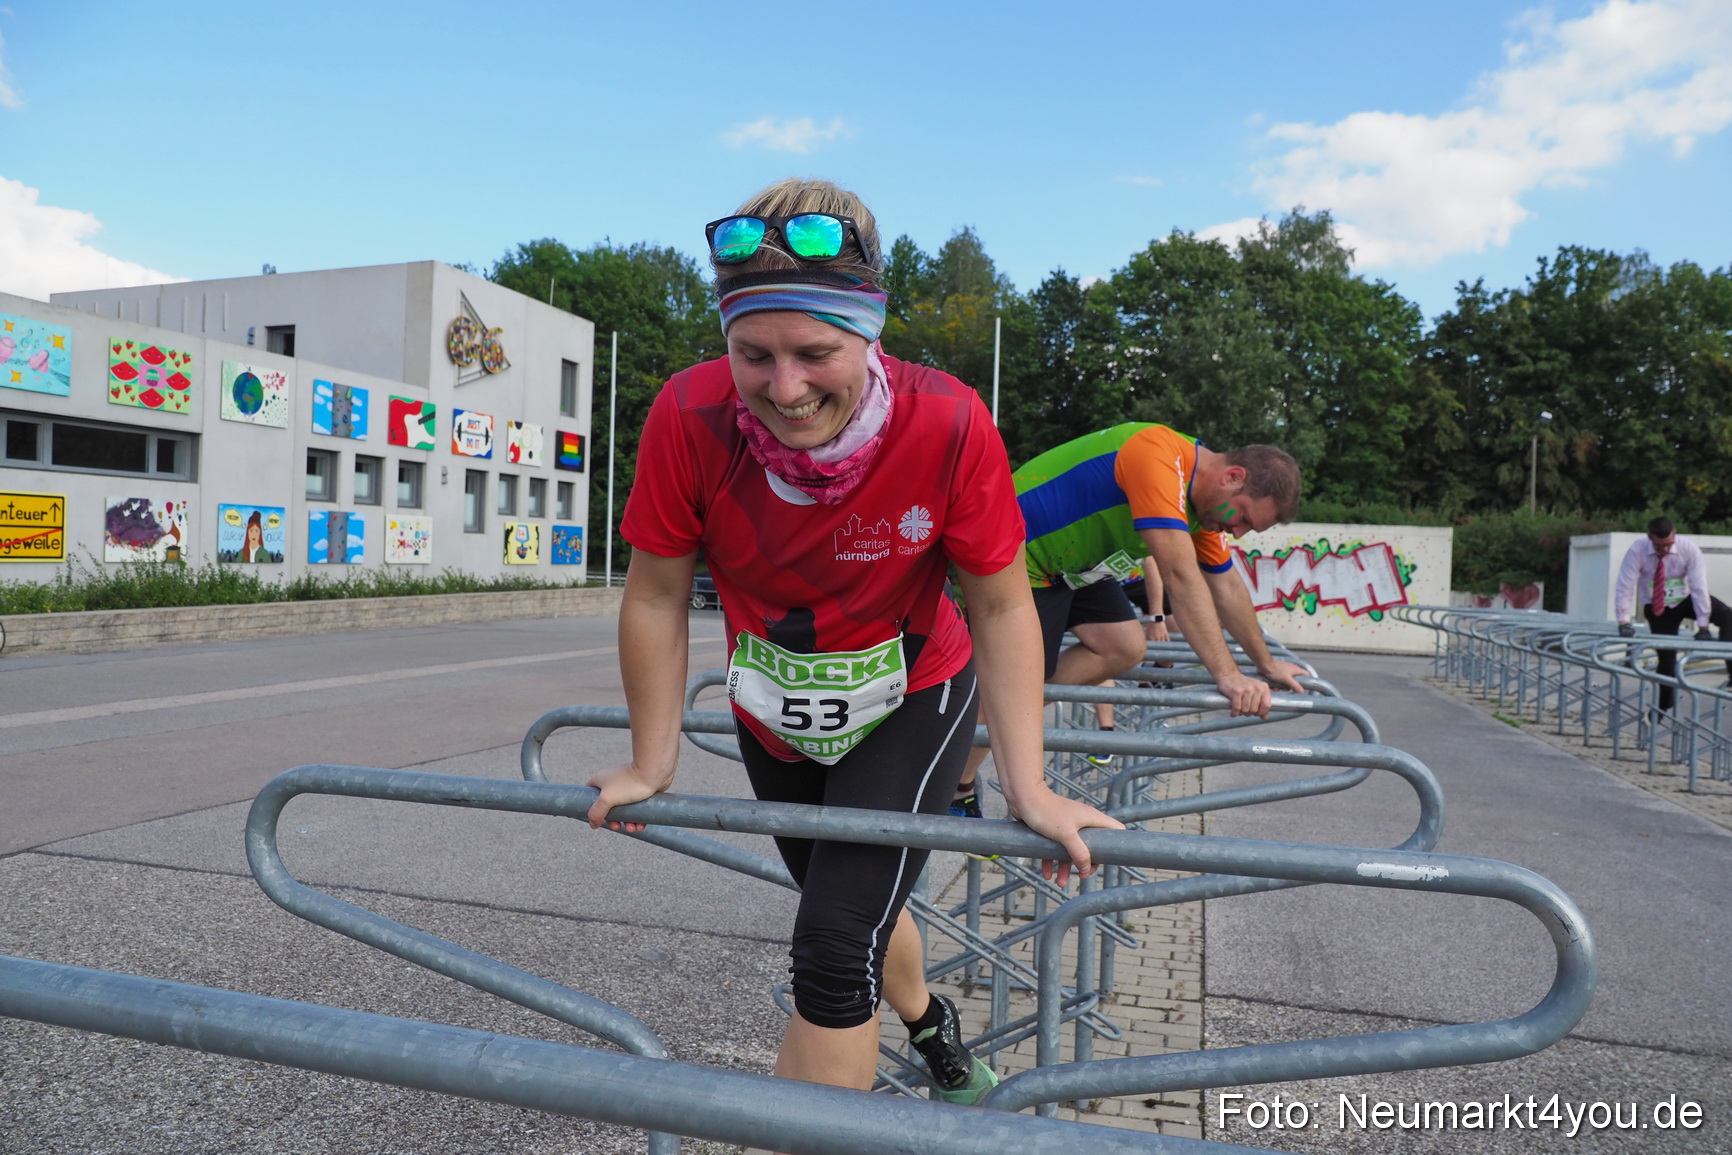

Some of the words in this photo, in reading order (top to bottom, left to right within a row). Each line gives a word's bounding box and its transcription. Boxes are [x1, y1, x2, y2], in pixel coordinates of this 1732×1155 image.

[835, 548, 890, 562] nürnberg
[853, 538, 891, 549] caritas
[749, 635, 891, 685] BOCK
[781, 695, 849, 732] 53
